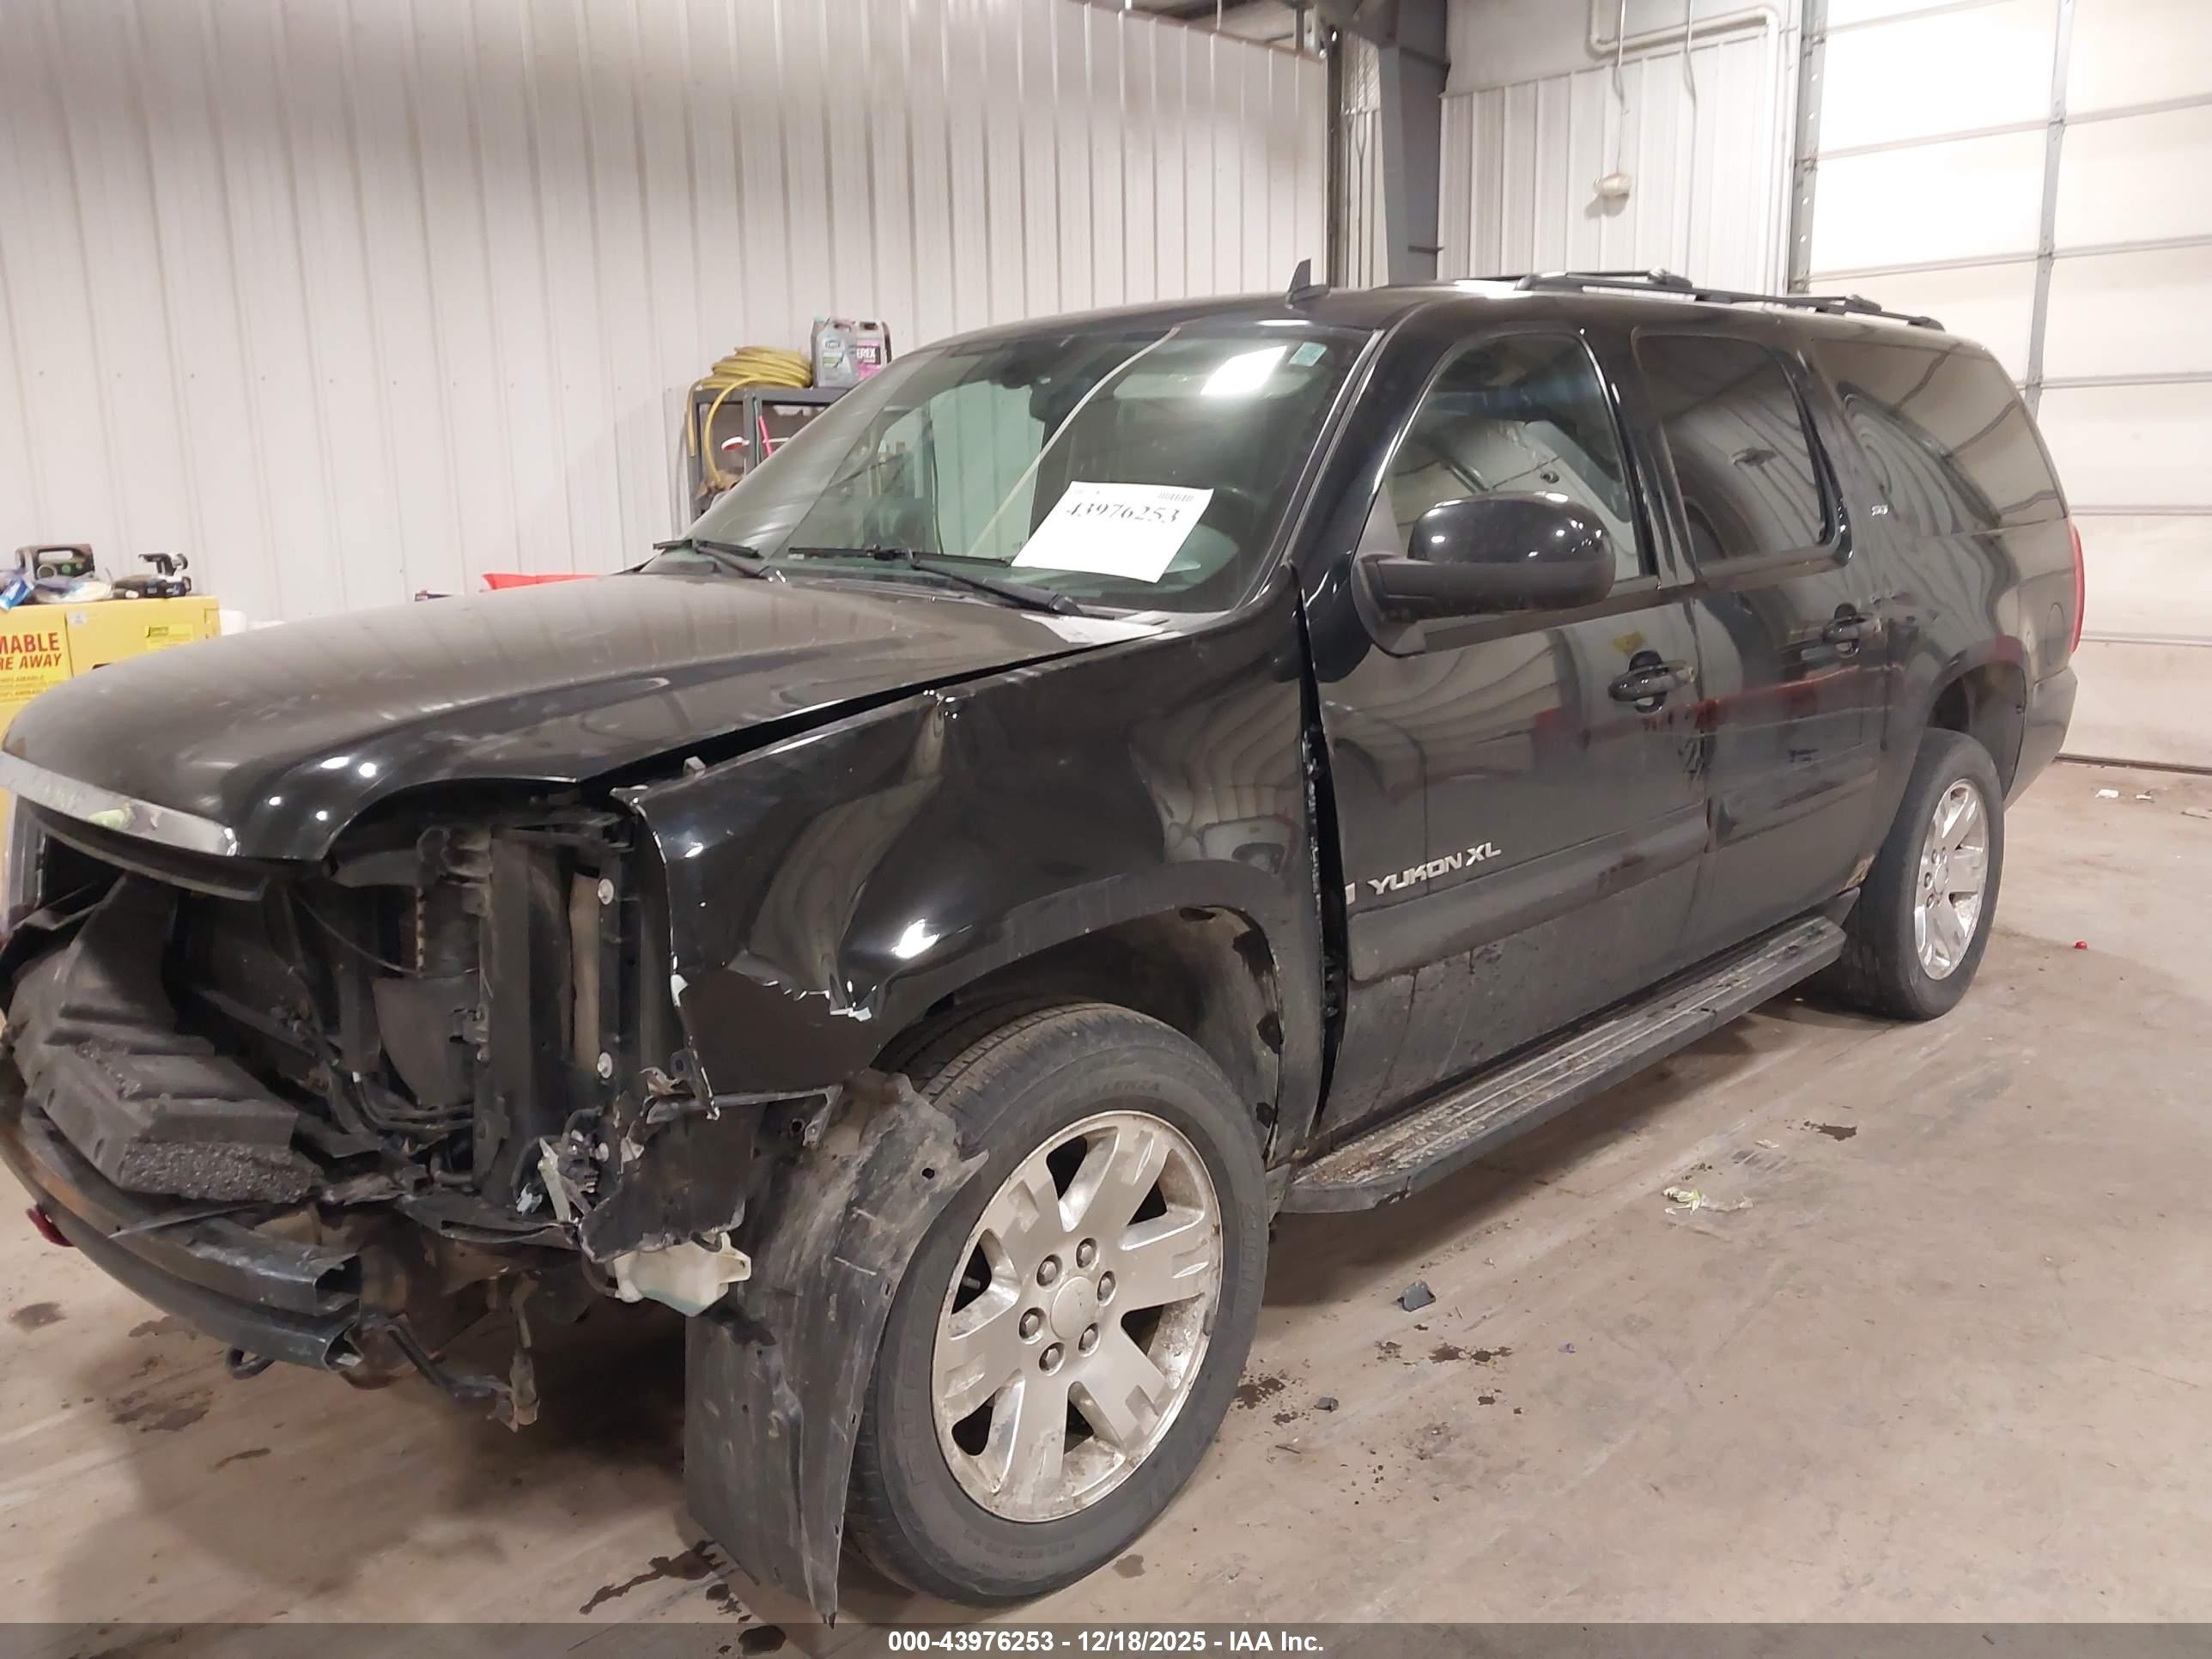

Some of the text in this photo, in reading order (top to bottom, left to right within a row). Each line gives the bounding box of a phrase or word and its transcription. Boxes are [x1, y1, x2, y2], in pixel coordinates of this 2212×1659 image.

[19, 653, 62, 669] AWAY
[1368, 842, 1502, 895] YUKON XL
